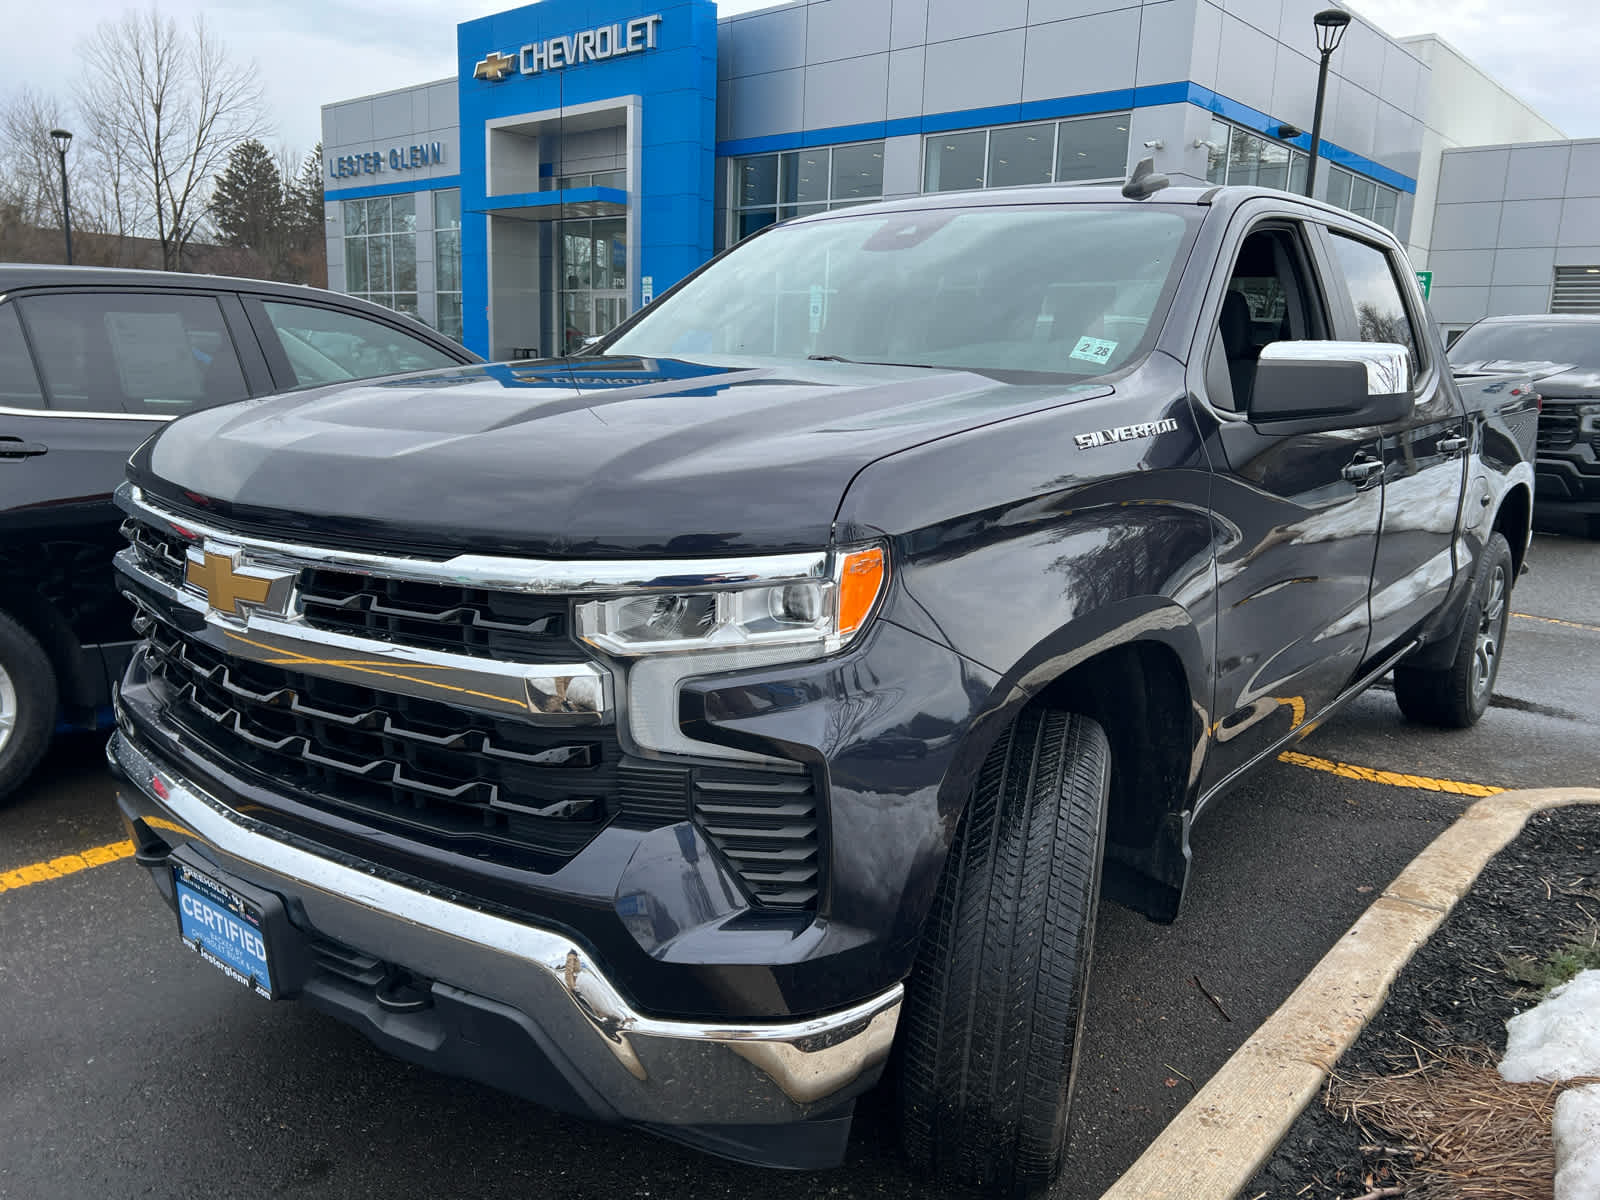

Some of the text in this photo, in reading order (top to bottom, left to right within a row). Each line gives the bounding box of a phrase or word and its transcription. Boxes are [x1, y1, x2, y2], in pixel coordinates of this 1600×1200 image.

[519, 13, 662, 76] CHEVROLET
[329, 141, 442, 178] LESTER GLENN
[1080, 343, 1110, 357] 2 28
[1074, 418, 1178, 450] SILVERADO
[181, 893, 267, 962] CERTIFIED
